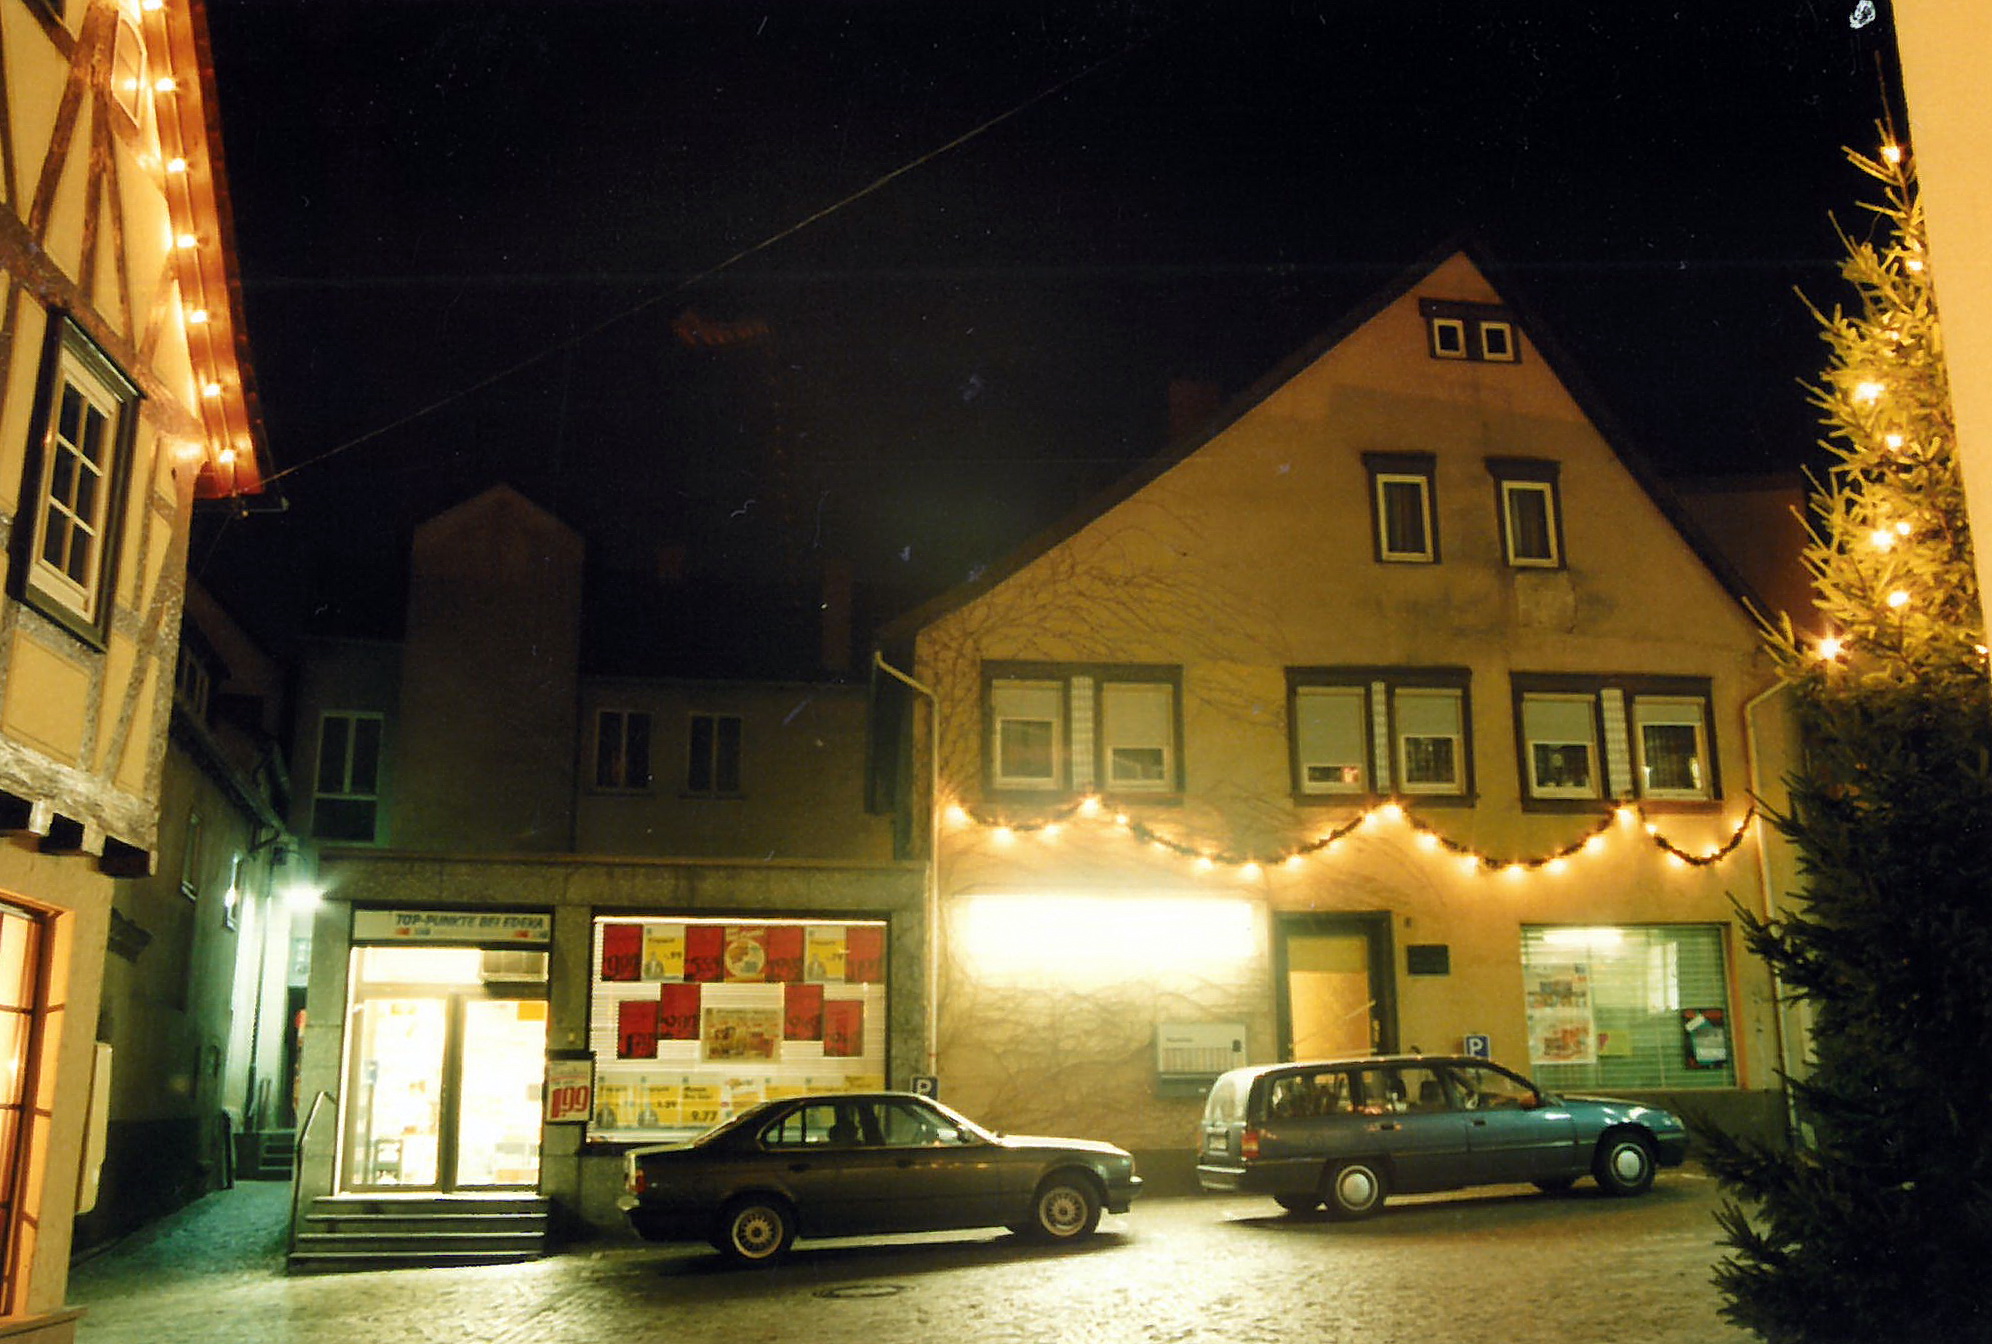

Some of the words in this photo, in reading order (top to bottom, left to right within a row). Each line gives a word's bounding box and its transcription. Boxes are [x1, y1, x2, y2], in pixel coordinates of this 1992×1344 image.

[503, 916, 544, 929] EDEKA
[1468, 1037, 1483, 1057] P
[916, 1078, 931, 1096] P
